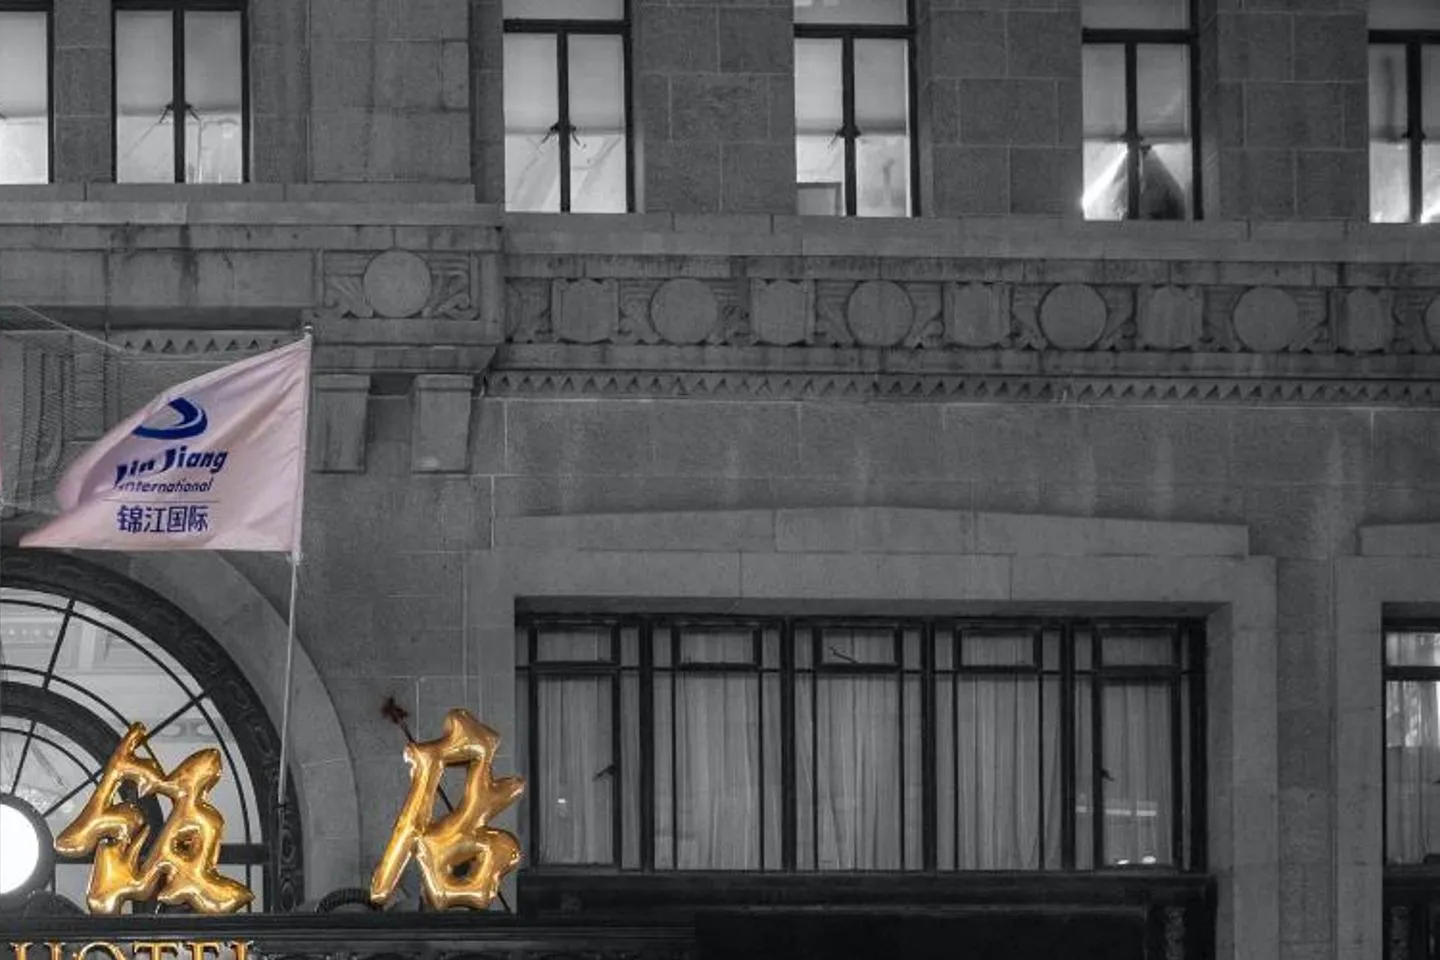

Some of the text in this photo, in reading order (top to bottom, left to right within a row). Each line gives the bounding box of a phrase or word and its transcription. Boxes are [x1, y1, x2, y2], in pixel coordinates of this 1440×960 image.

[154, 445, 229, 475] Jiang
[117, 504, 209, 534] 锦江国际
